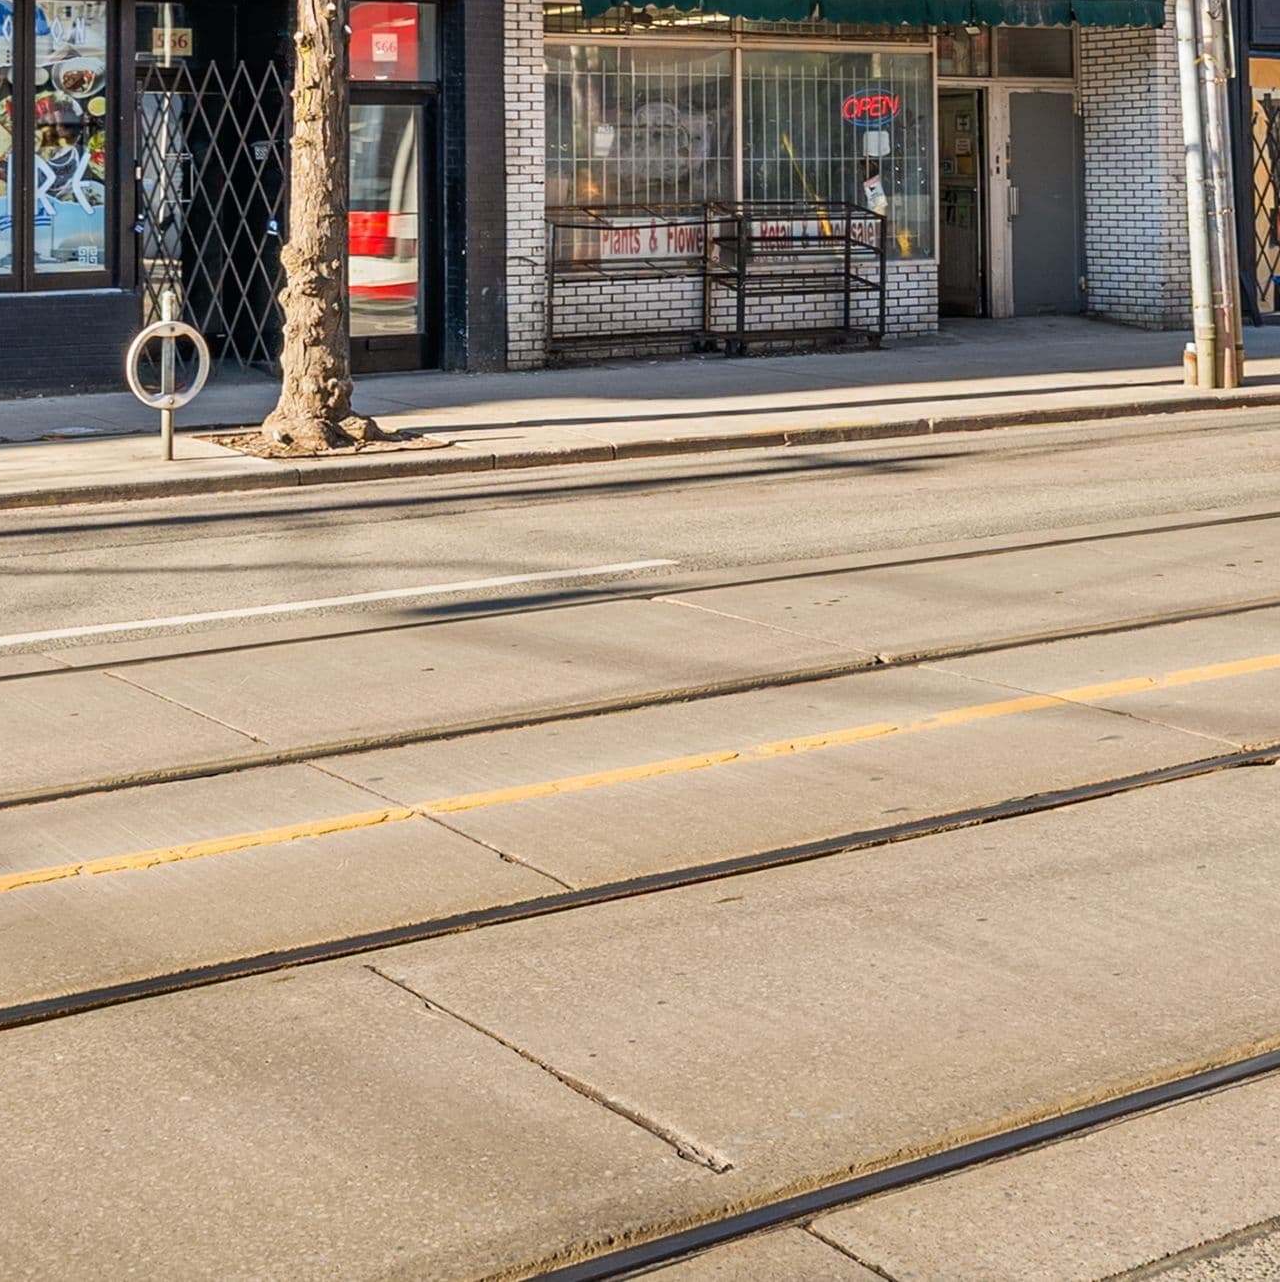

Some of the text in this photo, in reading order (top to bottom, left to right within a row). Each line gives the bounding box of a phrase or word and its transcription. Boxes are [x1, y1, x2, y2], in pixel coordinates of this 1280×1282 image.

[843, 94, 901, 120] OPEN
[601, 220, 641, 256] Plants
[667, 221, 716, 254] Flowe
